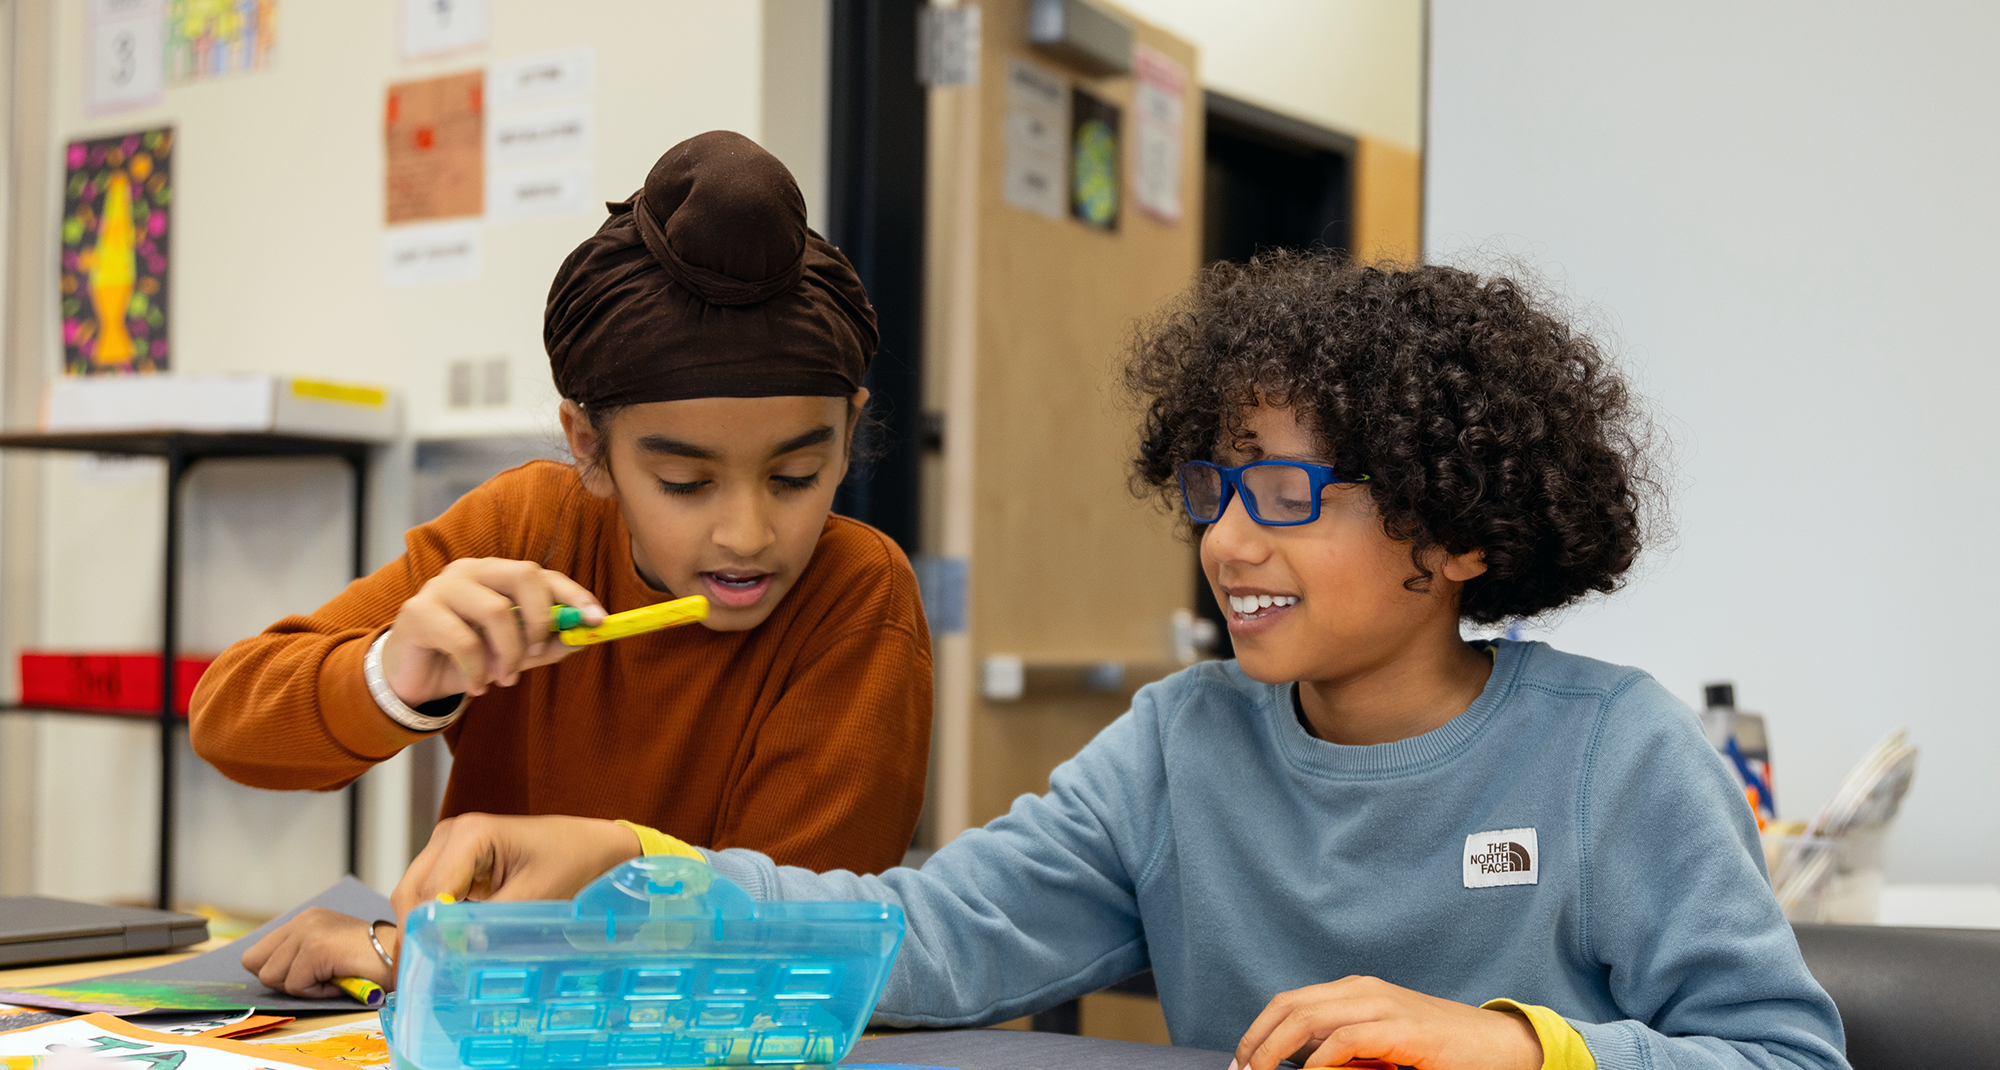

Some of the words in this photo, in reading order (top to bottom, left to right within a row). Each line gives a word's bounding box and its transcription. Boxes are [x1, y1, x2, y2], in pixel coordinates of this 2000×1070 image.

[110, 30, 136, 87] 3
[1487, 842, 1508, 853] THE
[1470, 852, 1509, 865] NORTH
[1481, 862, 1509, 874] FACE
